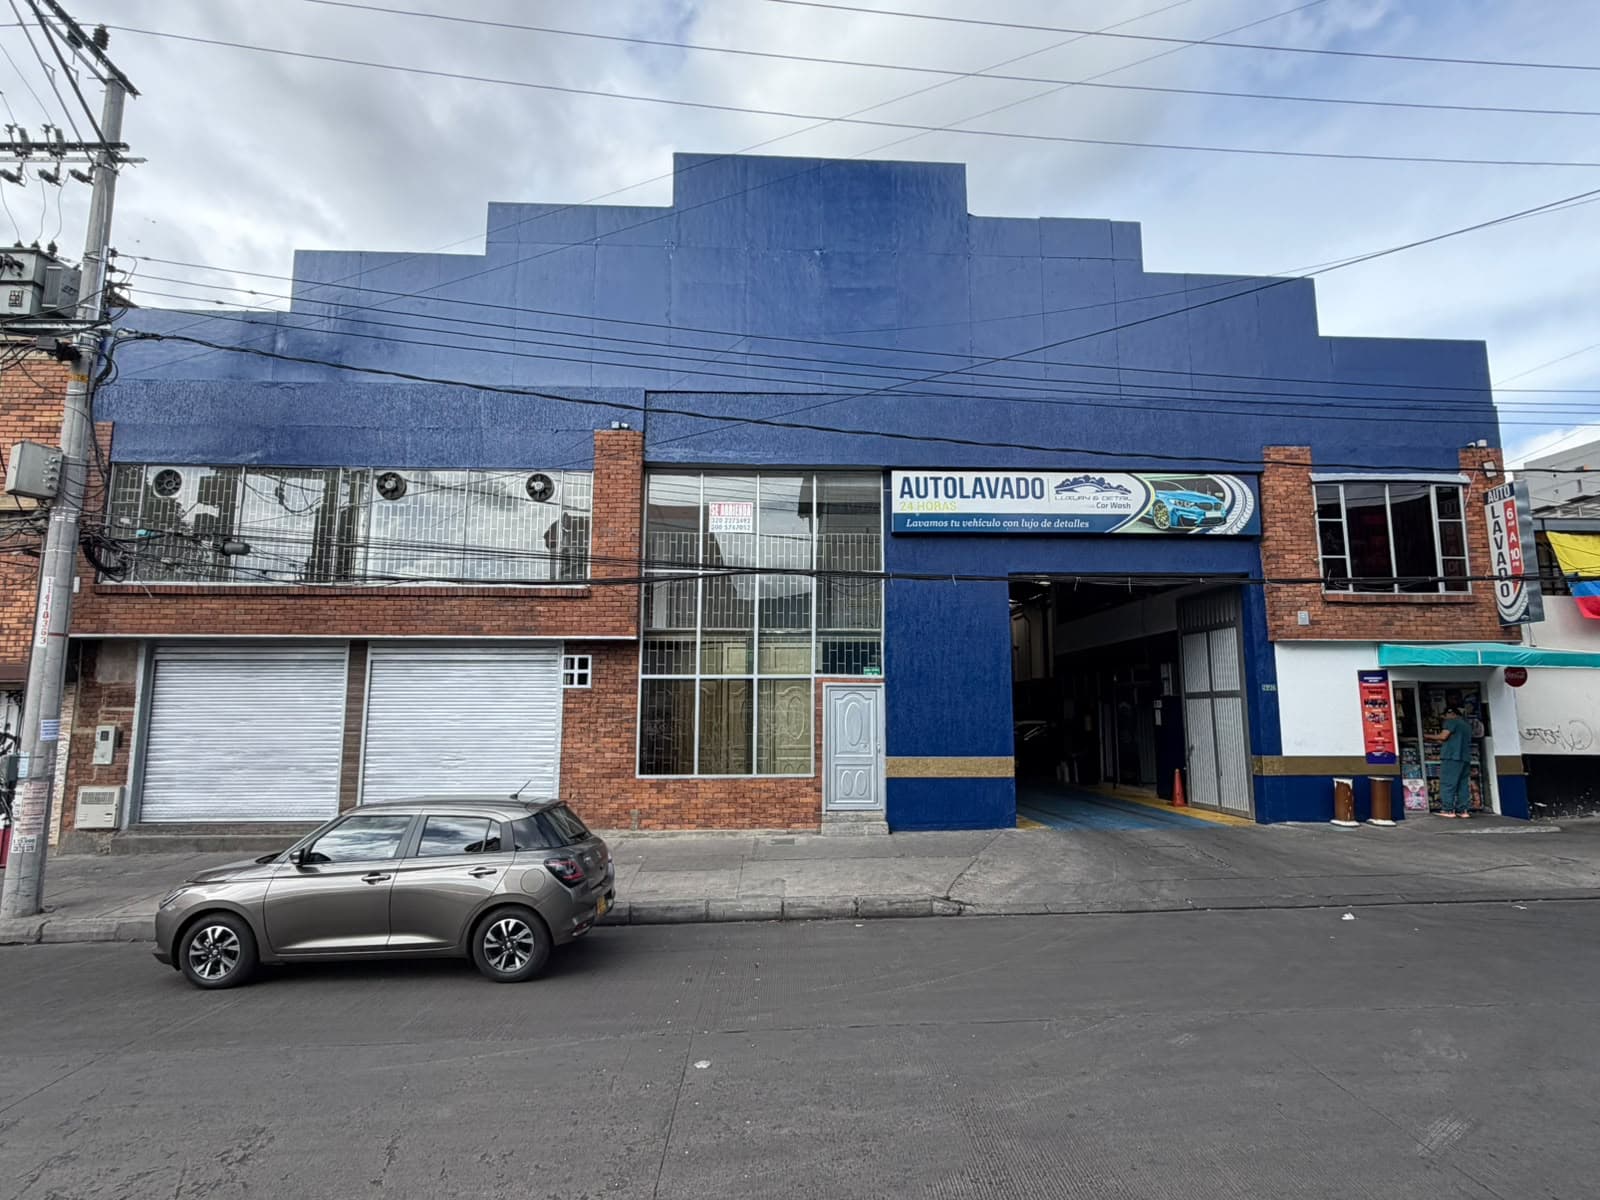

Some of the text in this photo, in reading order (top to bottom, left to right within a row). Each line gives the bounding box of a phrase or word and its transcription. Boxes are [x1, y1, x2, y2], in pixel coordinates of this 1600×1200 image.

[900, 476, 1045, 499] AUTOLAVADO
[1487, 485, 1511, 503] AUTO
[900, 501, 957, 511] 24 HORAS
[1506, 508, 1514, 520] 6
[906, 518, 949, 528] Lavamos
[950, 519, 960, 527] tu
[962, 518, 1001, 528] vehículo
[1021, 518, 1039, 529] lujo
[1040, 518, 1052, 528] de
[1053, 518, 1090, 528] detalles
[1510, 532, 1517, 543] A
[1511, 548, 1520, 560] 10
